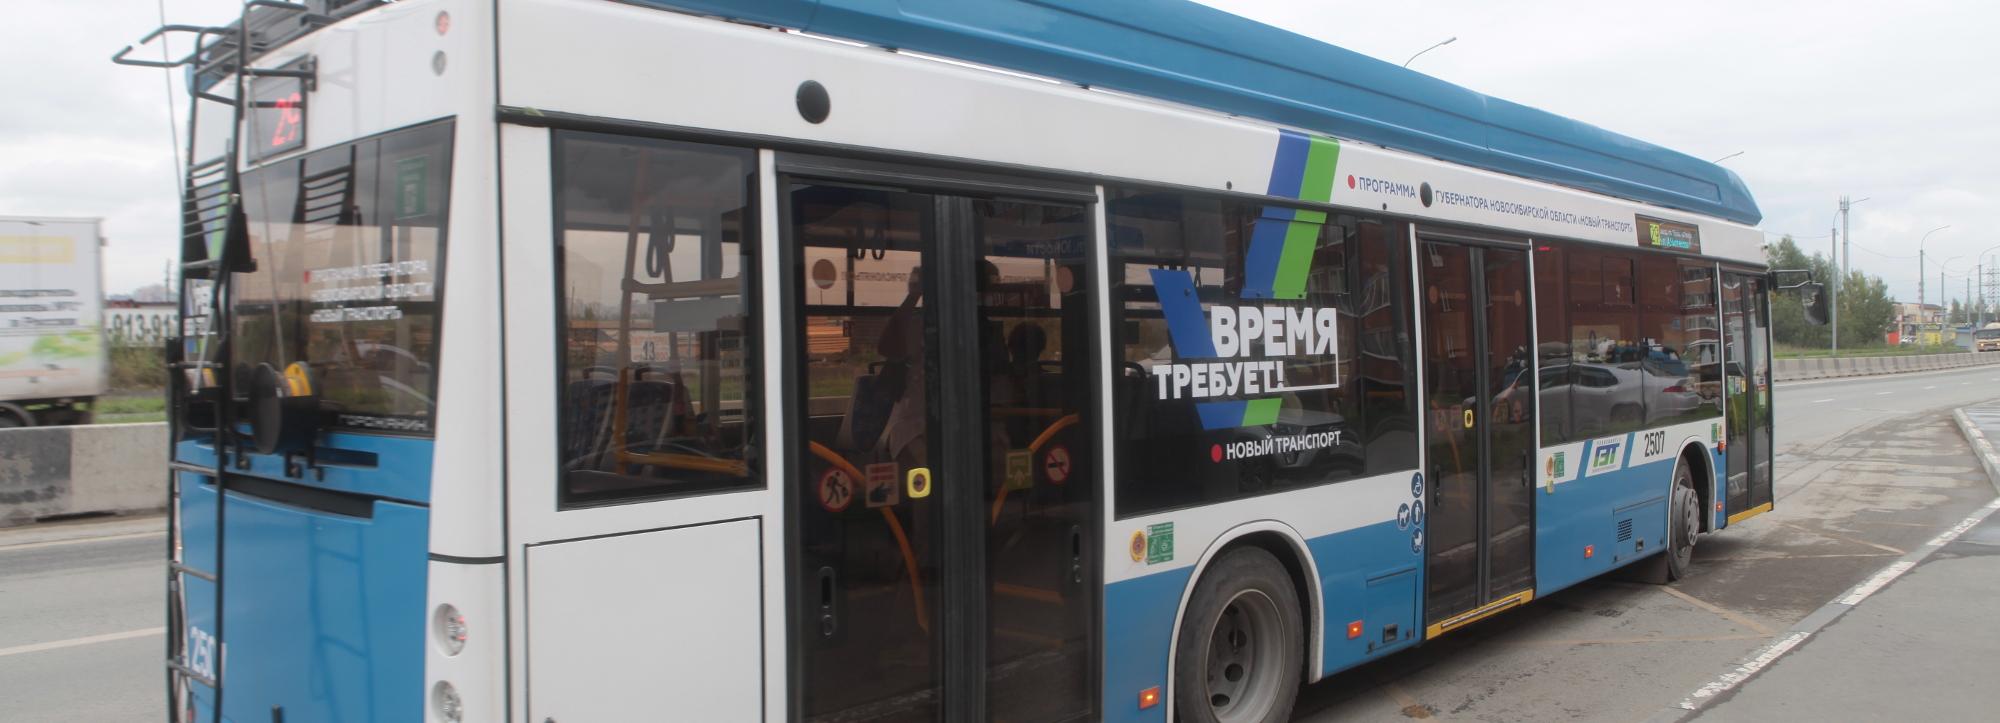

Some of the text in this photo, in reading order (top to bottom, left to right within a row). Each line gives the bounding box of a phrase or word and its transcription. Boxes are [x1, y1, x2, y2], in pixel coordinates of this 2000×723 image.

[1358, 176, 1417, 199] ПРОГРАММА
[1435, 190, 1489, 210] ГУБЕРНАТОРА
[1489, 199, 1549, 220] НОВОСИБИРСКОЙ
[1550, 210, 1578, 226] ОБЛАСТИ
[1211, 306, 1337, 357] ВРЕМЯ
[1152, 361, 1284, 399] ТРЕБУЕТ!
[1226, 431, 1342, 460] НОВЫЙ ТРАНСПОРТ
[1644, 430, 1665, 457] 2507
[191, 626, 227, 688] 250
